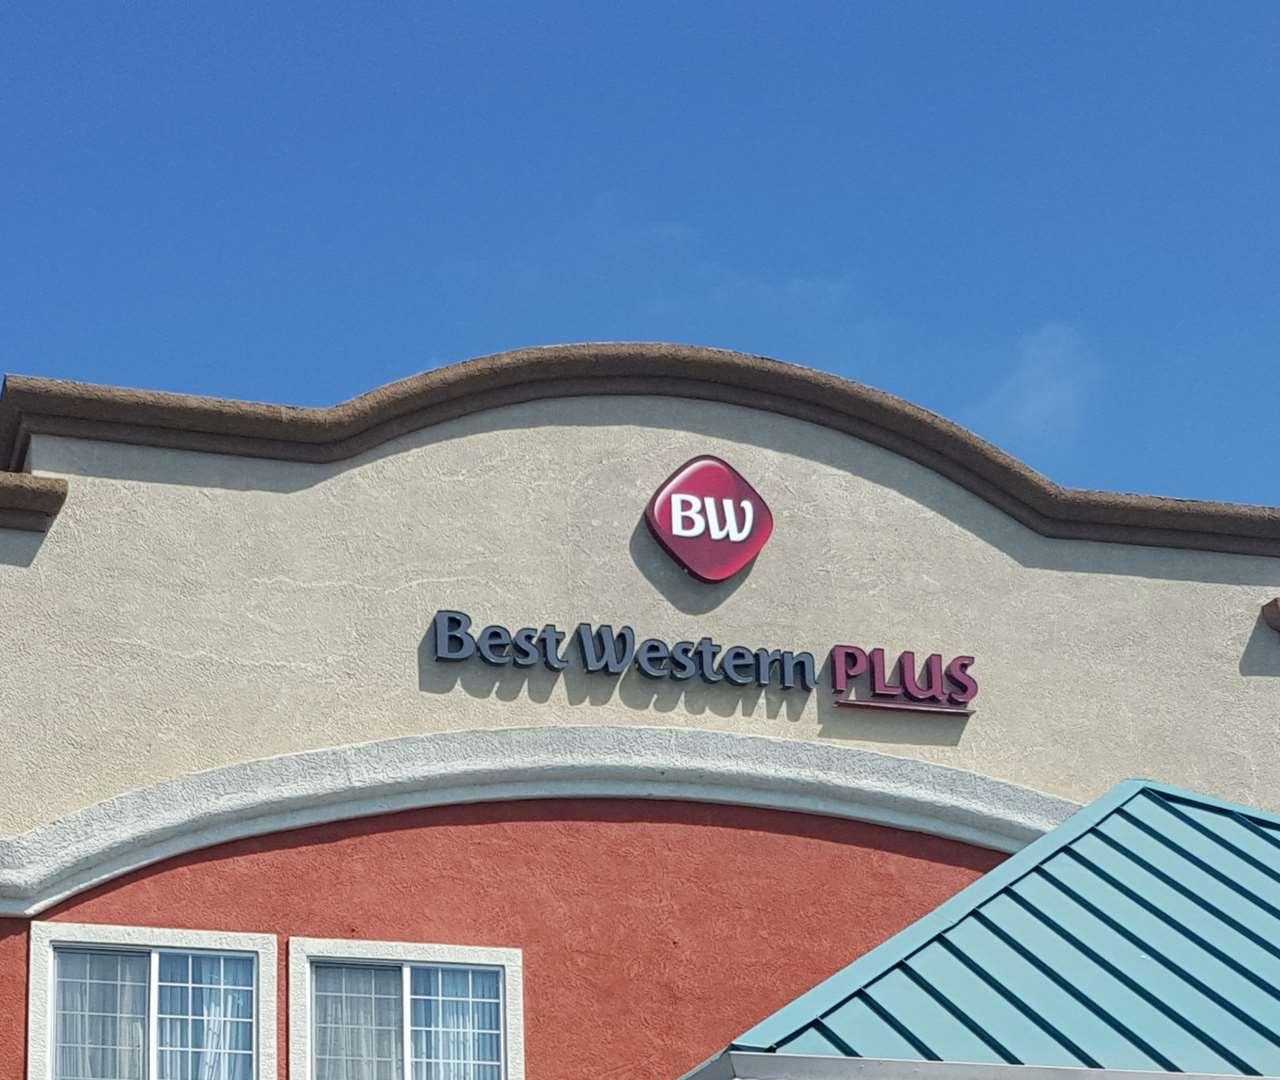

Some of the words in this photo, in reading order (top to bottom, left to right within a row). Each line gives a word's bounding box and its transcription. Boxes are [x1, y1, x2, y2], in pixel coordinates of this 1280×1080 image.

[671, 493, 754, 542] BW
[435, 610, 569, 672] Best
[577, 623, 818, 690] Western
[831, 645, 979, 704] PLUS
